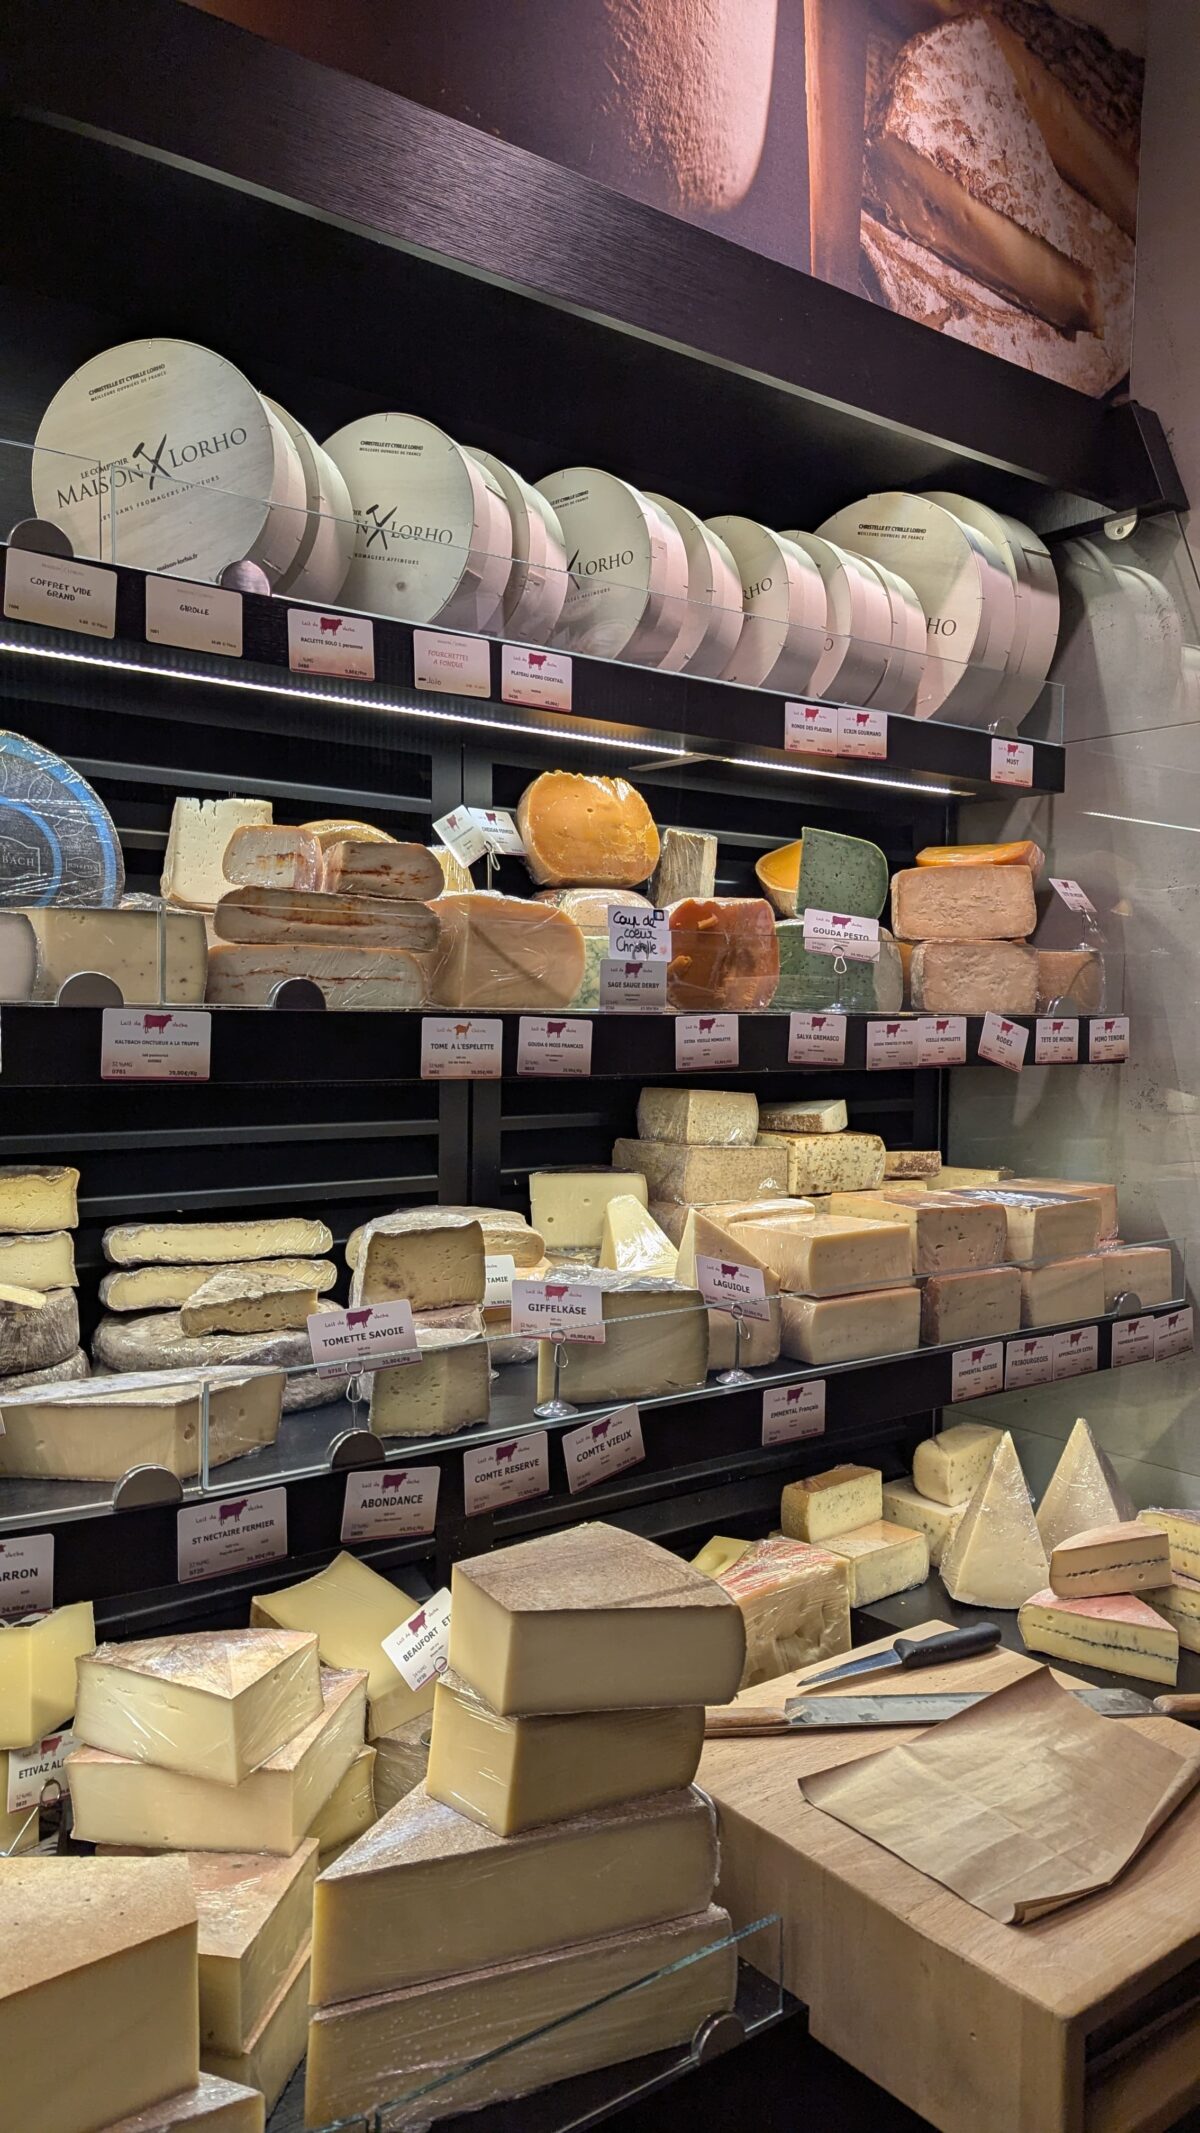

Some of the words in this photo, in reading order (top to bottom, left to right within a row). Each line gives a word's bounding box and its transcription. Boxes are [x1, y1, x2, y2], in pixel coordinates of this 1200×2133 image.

[57, 464, 144, 508] MAISON
[168, 427, 248, 468] LORHO
[80, 470, 90, 480] LE
[136, 488, 180, 508] FROMAGERS
[182, 475, 220, 492] AFFEURS
[578, 550, 634, 576] LORHO
[30, 576, 70, 592] COFFRET
[72, 586, 92, 597] VIDE
[46, 590, 76, 602] GRAND
[180, 604, 210, 616] GIROLLE
[440, 660, 464, 668] FONDUE
[510, 670, 530, 678] PLATEAU
[1006, 758, 1019, 766] MUST
[2, 854, 34, 866] BACH
[642, 916, 656, 928] de
[812, 926, 842, 938] GOUDA
[844, 932, 870, 941] PESTO
[996, 1034, 1013, 1047] RODEZ
[486, 1276, 508, 1284] TAMIE
[712, 1278, 750, 1294] LAGUIOLE
[528, 1303, 587, 1316] GIFFELKÄSE
[322, 1332, 367, 1347] TOMETTE
[369, 1326, 404, 1340] SAVOIE
[958, 1368, 982, 1378] EMMENTAL
[770, 1408, 798, 1418] EMMENTAL
[799, 1404, 818, 1412] Français
[576, 1442, 606, 1463] COMTE
[606, 1429, 632, 1448] VIEUX
[474, 1469, 503, 1484] COMTE
[504, 1458, 540, 1476] RESERVE
[360, 1494, 424, 1509] ABONDANCE
[192, 1536, 202, 1545] ST
[203, 1528, 240, 1542] NECTAIRE
[242, 1520, 275, 1532] FERMIER
[0, 1568, 38, 1582] RRON
[402, 1626, 440, 1662] BEAUFORT
[18, 1763, 50, 1779] ETIVAZ
